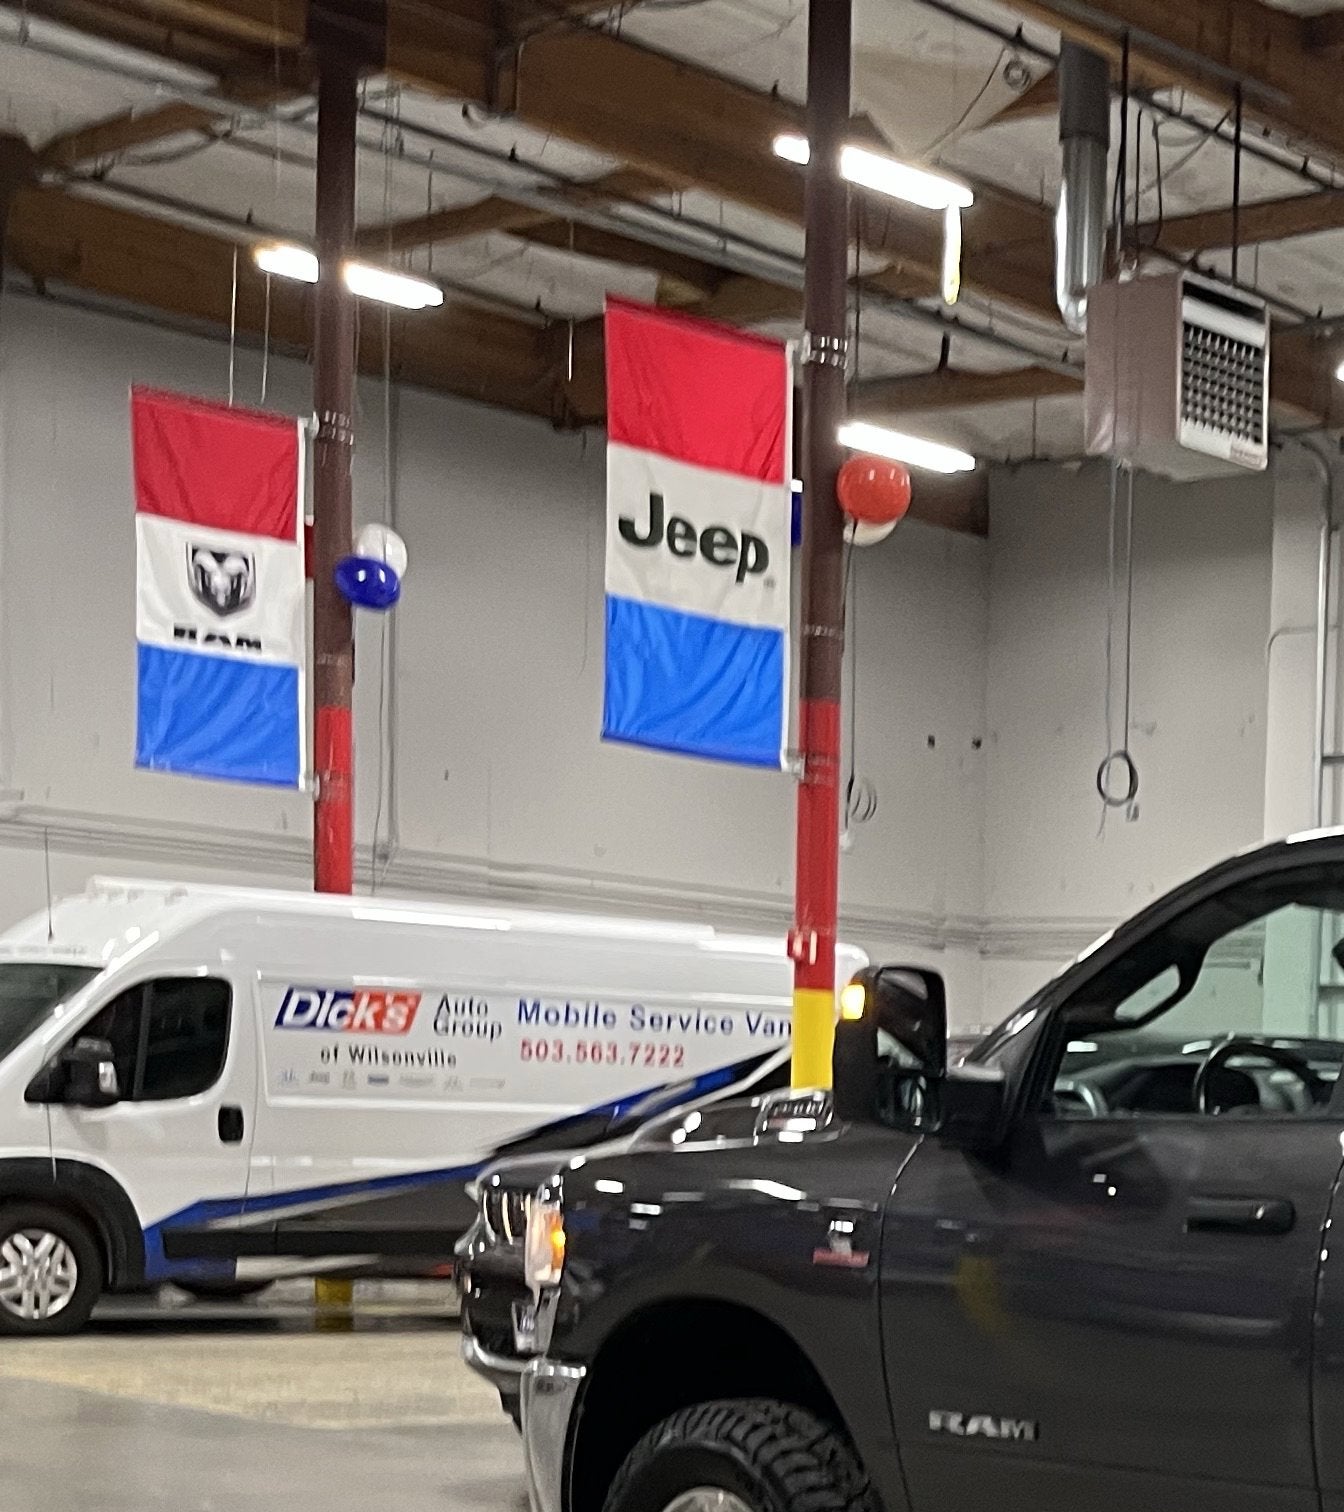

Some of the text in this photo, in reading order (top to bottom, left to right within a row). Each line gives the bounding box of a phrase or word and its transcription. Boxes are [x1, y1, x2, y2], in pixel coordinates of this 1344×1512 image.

[618, 490, 769, 583] Jeep
[433, 1012, 502, 1043] Group
[434, 991, 488, 1018] Auto
[518, 999, 617, 1030] Mobile
[629, 1003, 734, 1035] Service
[320, 1042, 457, 1069] of Wilsonville
[929, 1409, 1039, 1440] RAM
